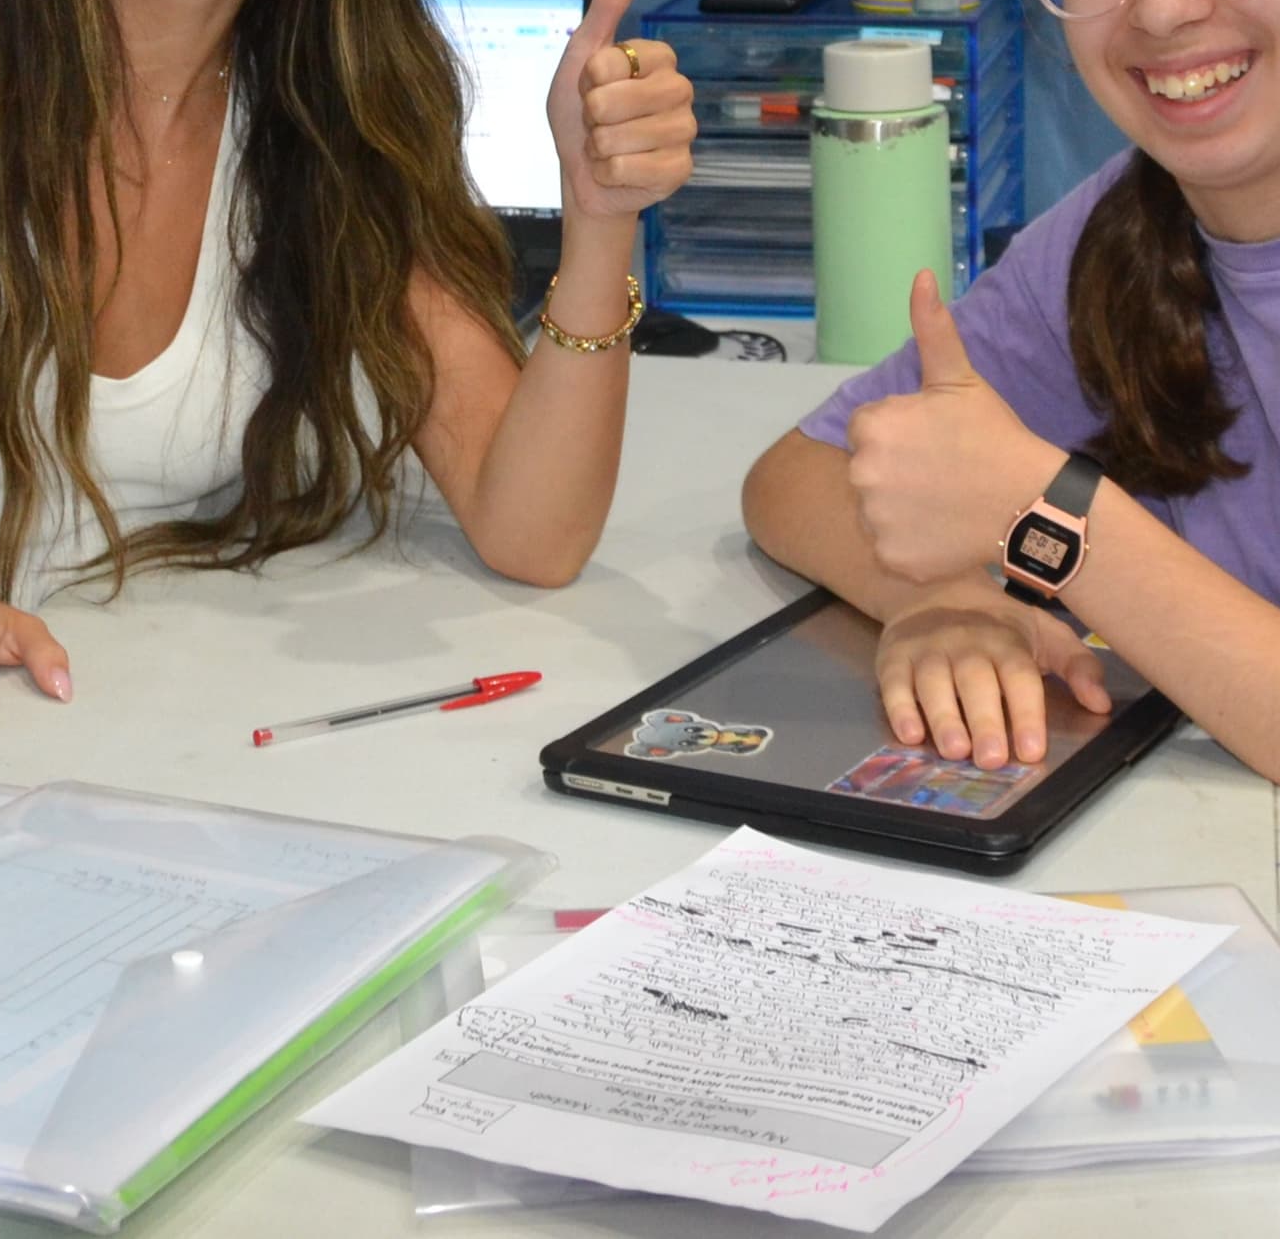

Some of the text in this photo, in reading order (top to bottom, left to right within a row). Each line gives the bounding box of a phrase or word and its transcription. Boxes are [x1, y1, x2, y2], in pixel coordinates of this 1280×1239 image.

[523, 1041, 579, 1058] ambiguity
[582, 1056, 608, 1065] uses
[611, 1063, 684, 1082] Shakespeare
[688, 1078, 721, 1087] HOW
[725, 1083, 775, 1093] explains
[528, 1091, 591, 1110] Macbeth
[605, 1086, 656, 1102] Witches
[777, 1090, 803, 1099] that
[663, 1097, 686, 1106] the
[807, 1096, 873, 1111] paragraph
[607, 1107, 643, 1121] Stage
[886, 1112, 921, 1125] Write
[671, 1118, 689, 1126] for
[693, 1119, 757, 1137] Kingdom
